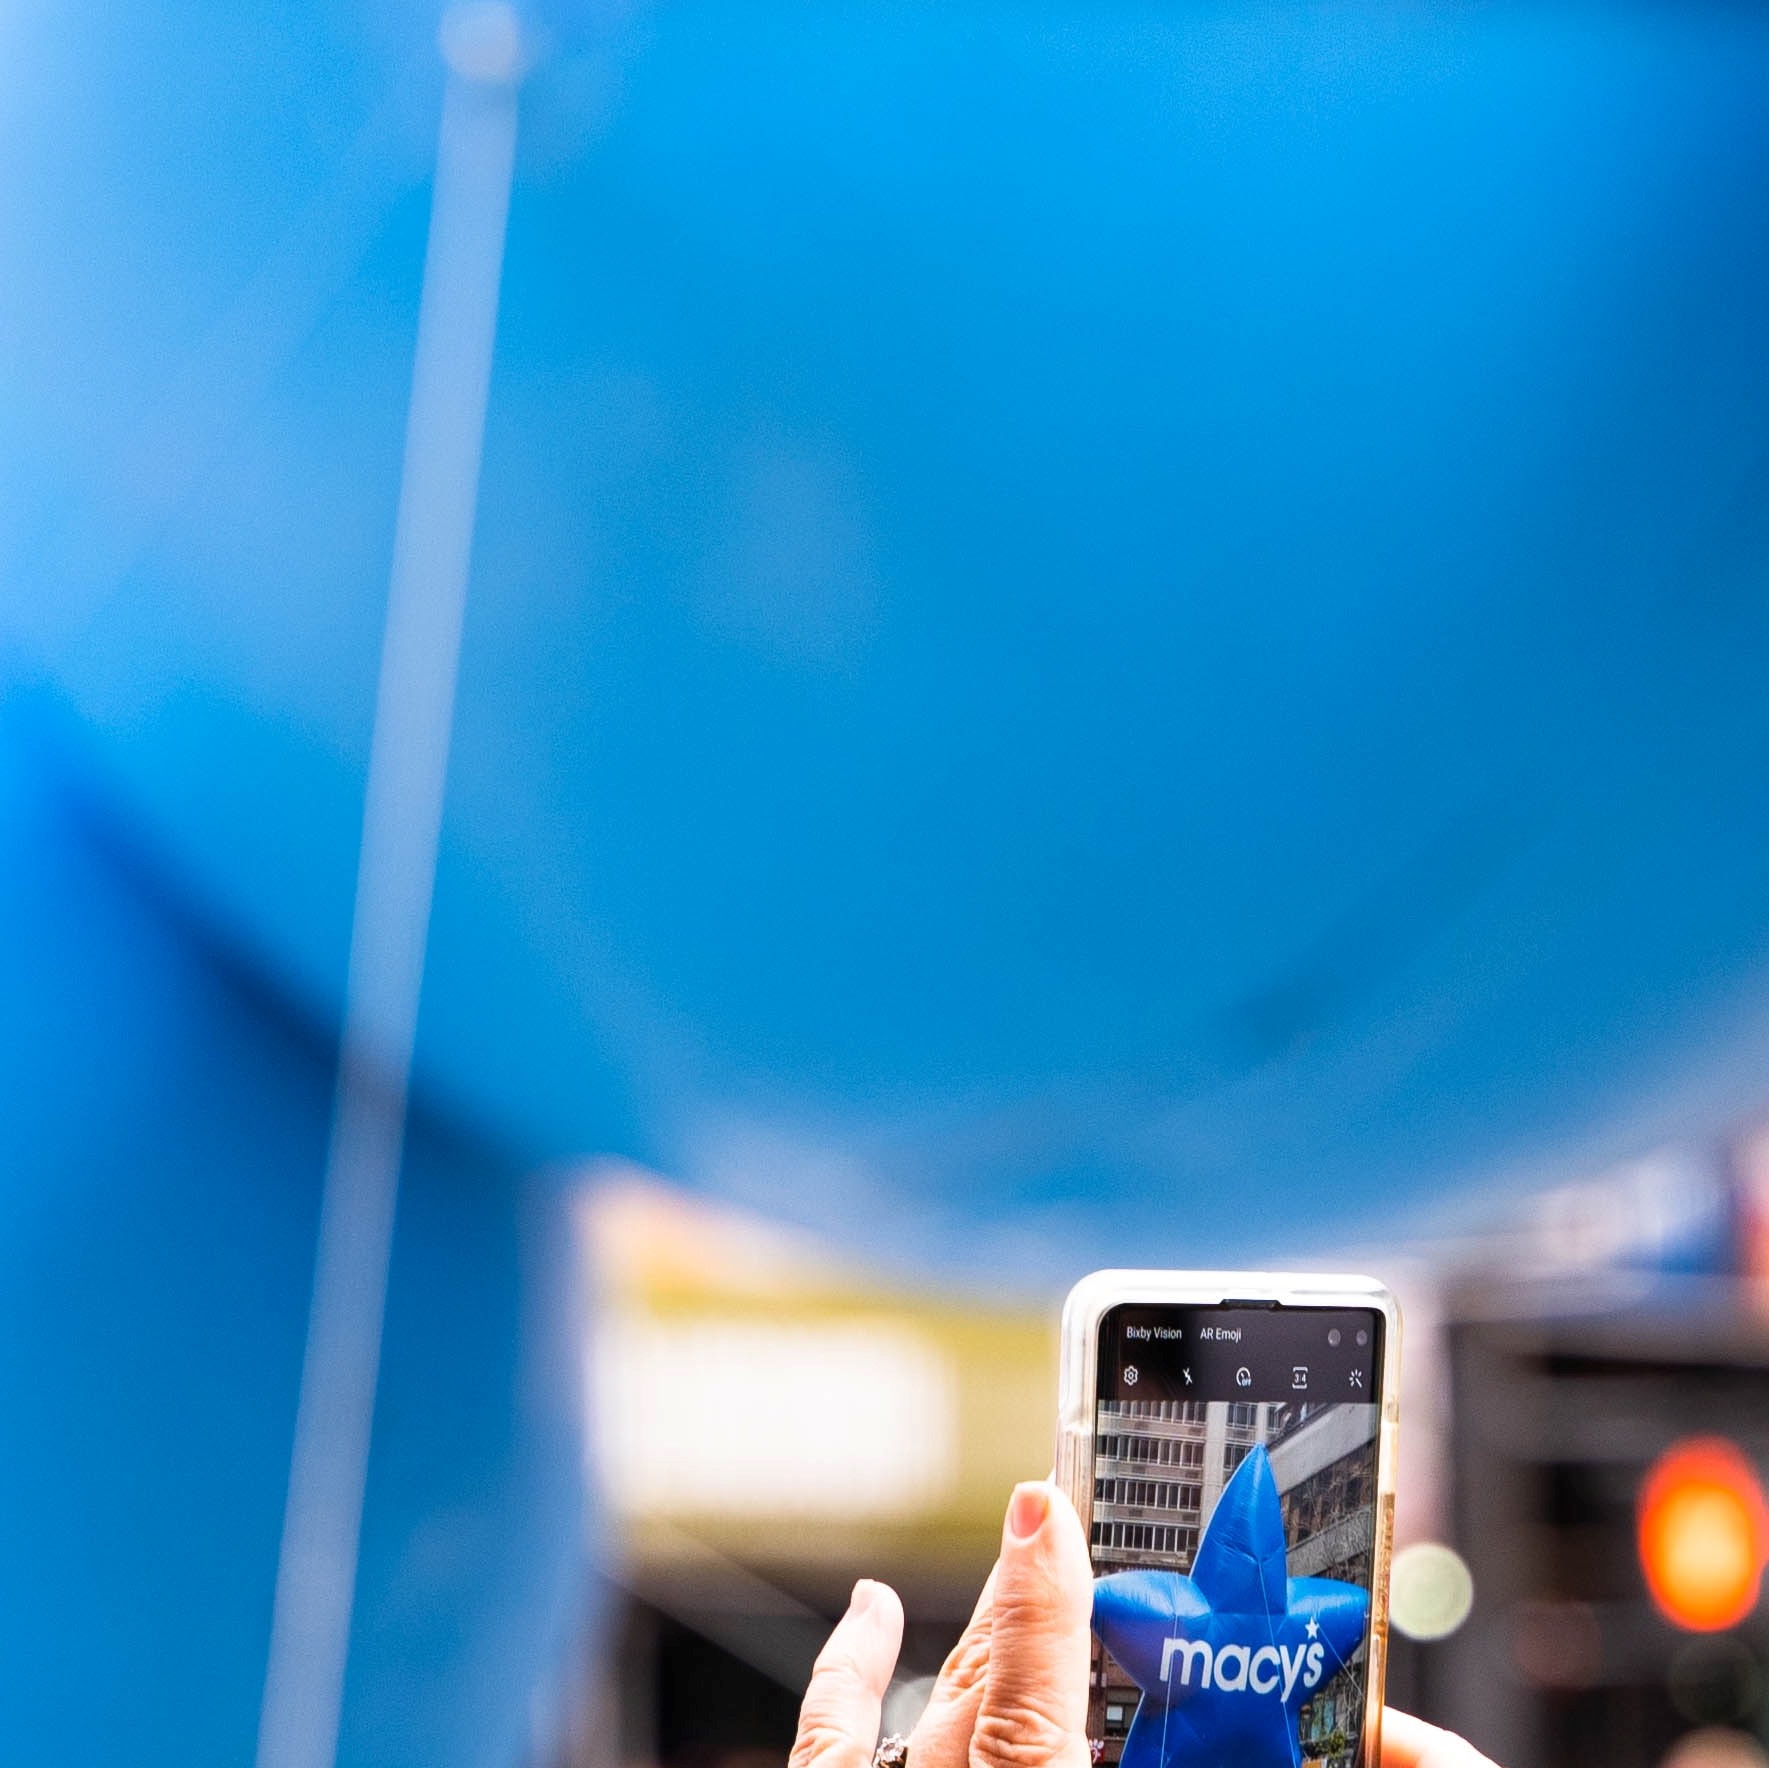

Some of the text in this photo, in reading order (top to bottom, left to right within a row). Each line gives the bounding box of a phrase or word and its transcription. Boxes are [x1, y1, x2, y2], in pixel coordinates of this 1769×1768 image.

[1126, 1326, 1182, 1341] Bixby Vision
[1200, 1328, 1242, 1343] AR Emoji
